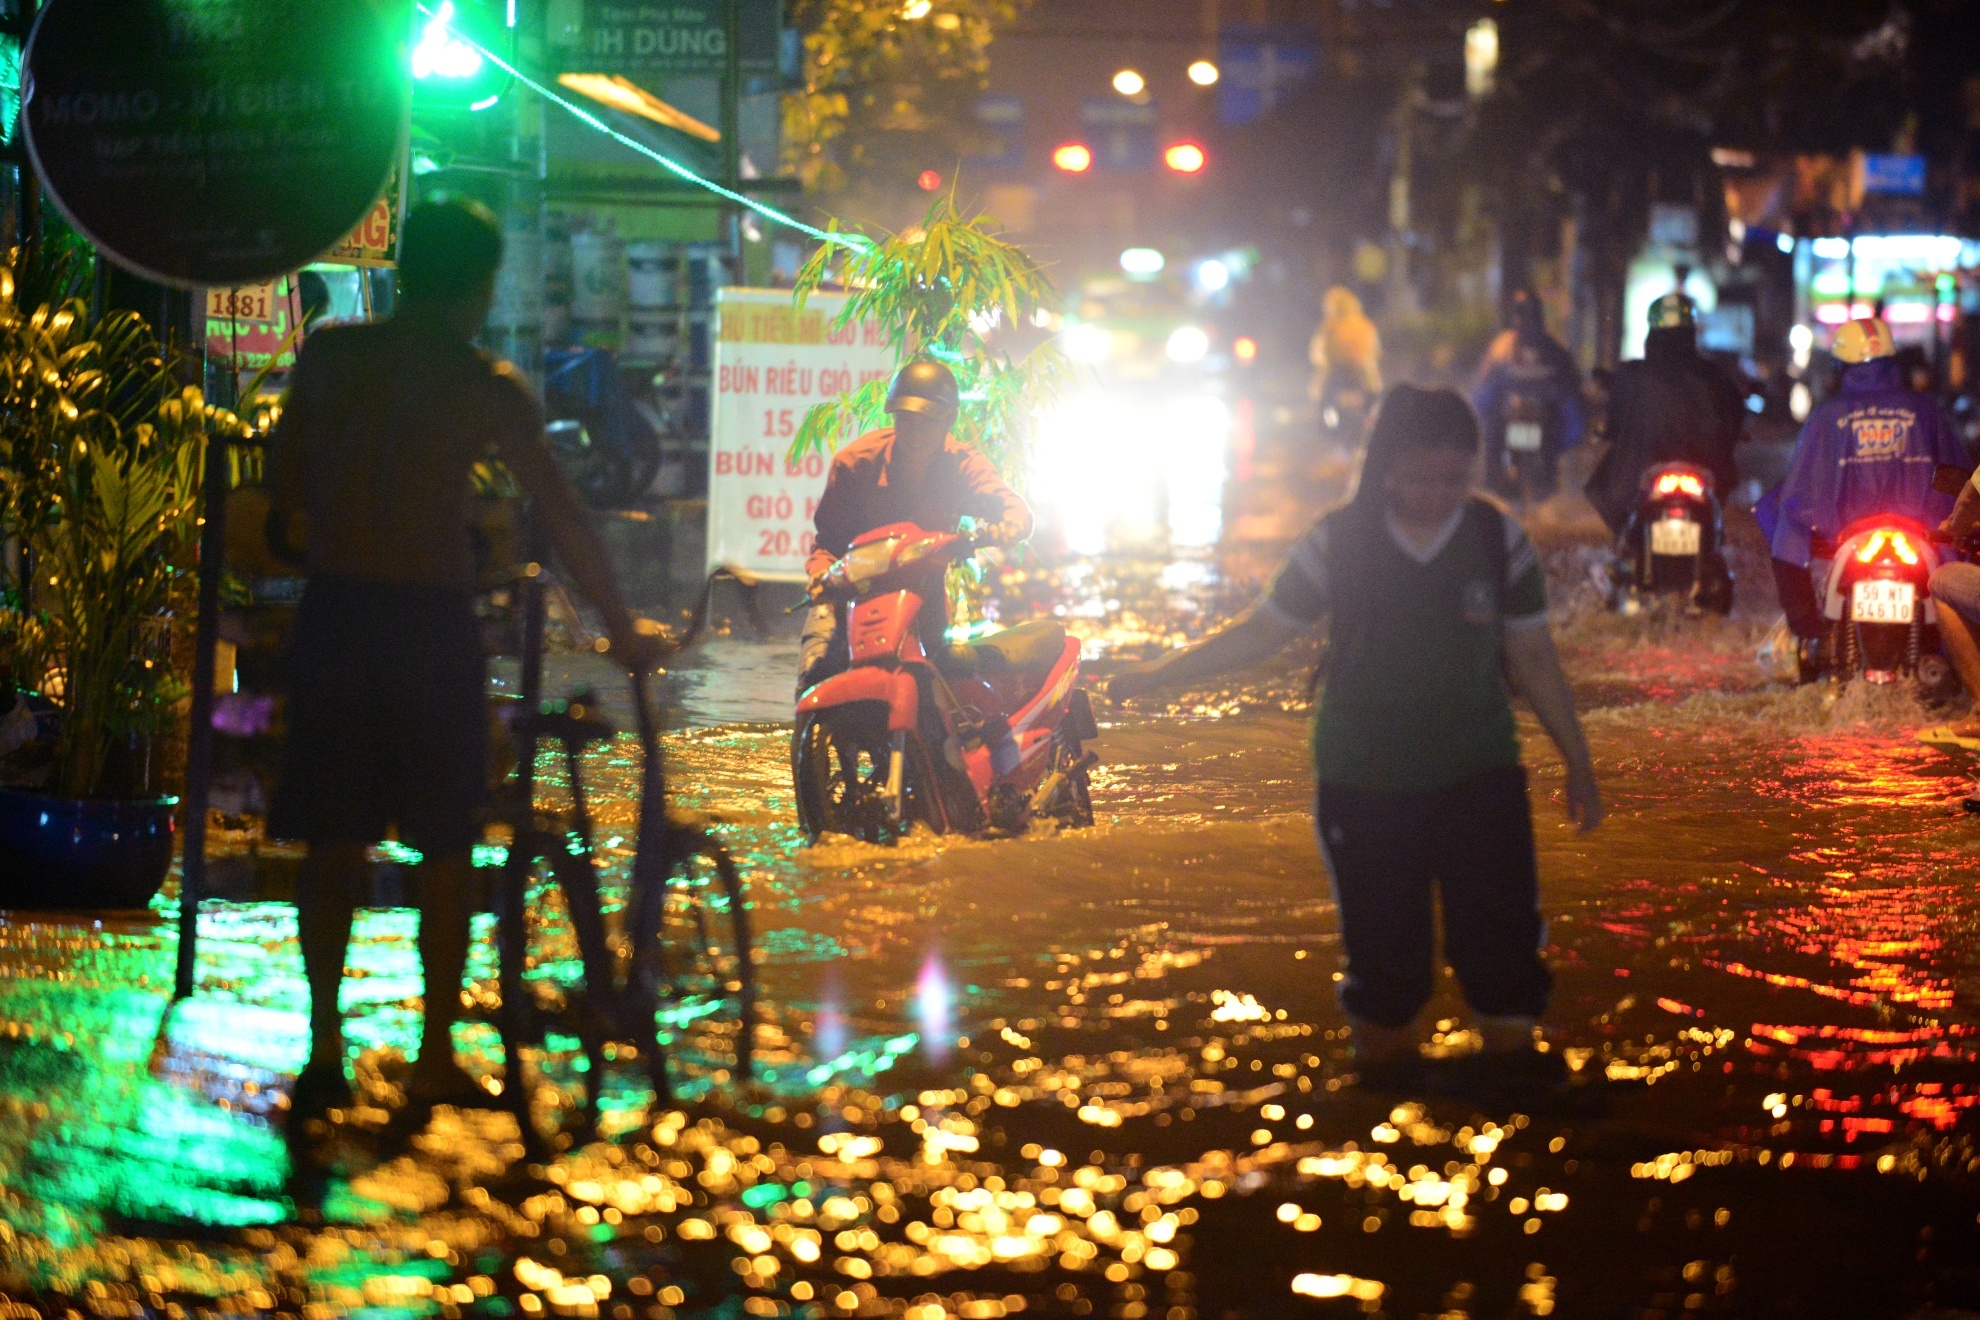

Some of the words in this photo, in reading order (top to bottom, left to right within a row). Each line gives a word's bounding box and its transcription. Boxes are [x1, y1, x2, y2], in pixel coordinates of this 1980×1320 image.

[213, 293, 267, 319] 1881
[718, 357, 760, 394] BÚN
[714, 445, 775, 477] BÚN
[747, 488, 794, 520] GIÒ
